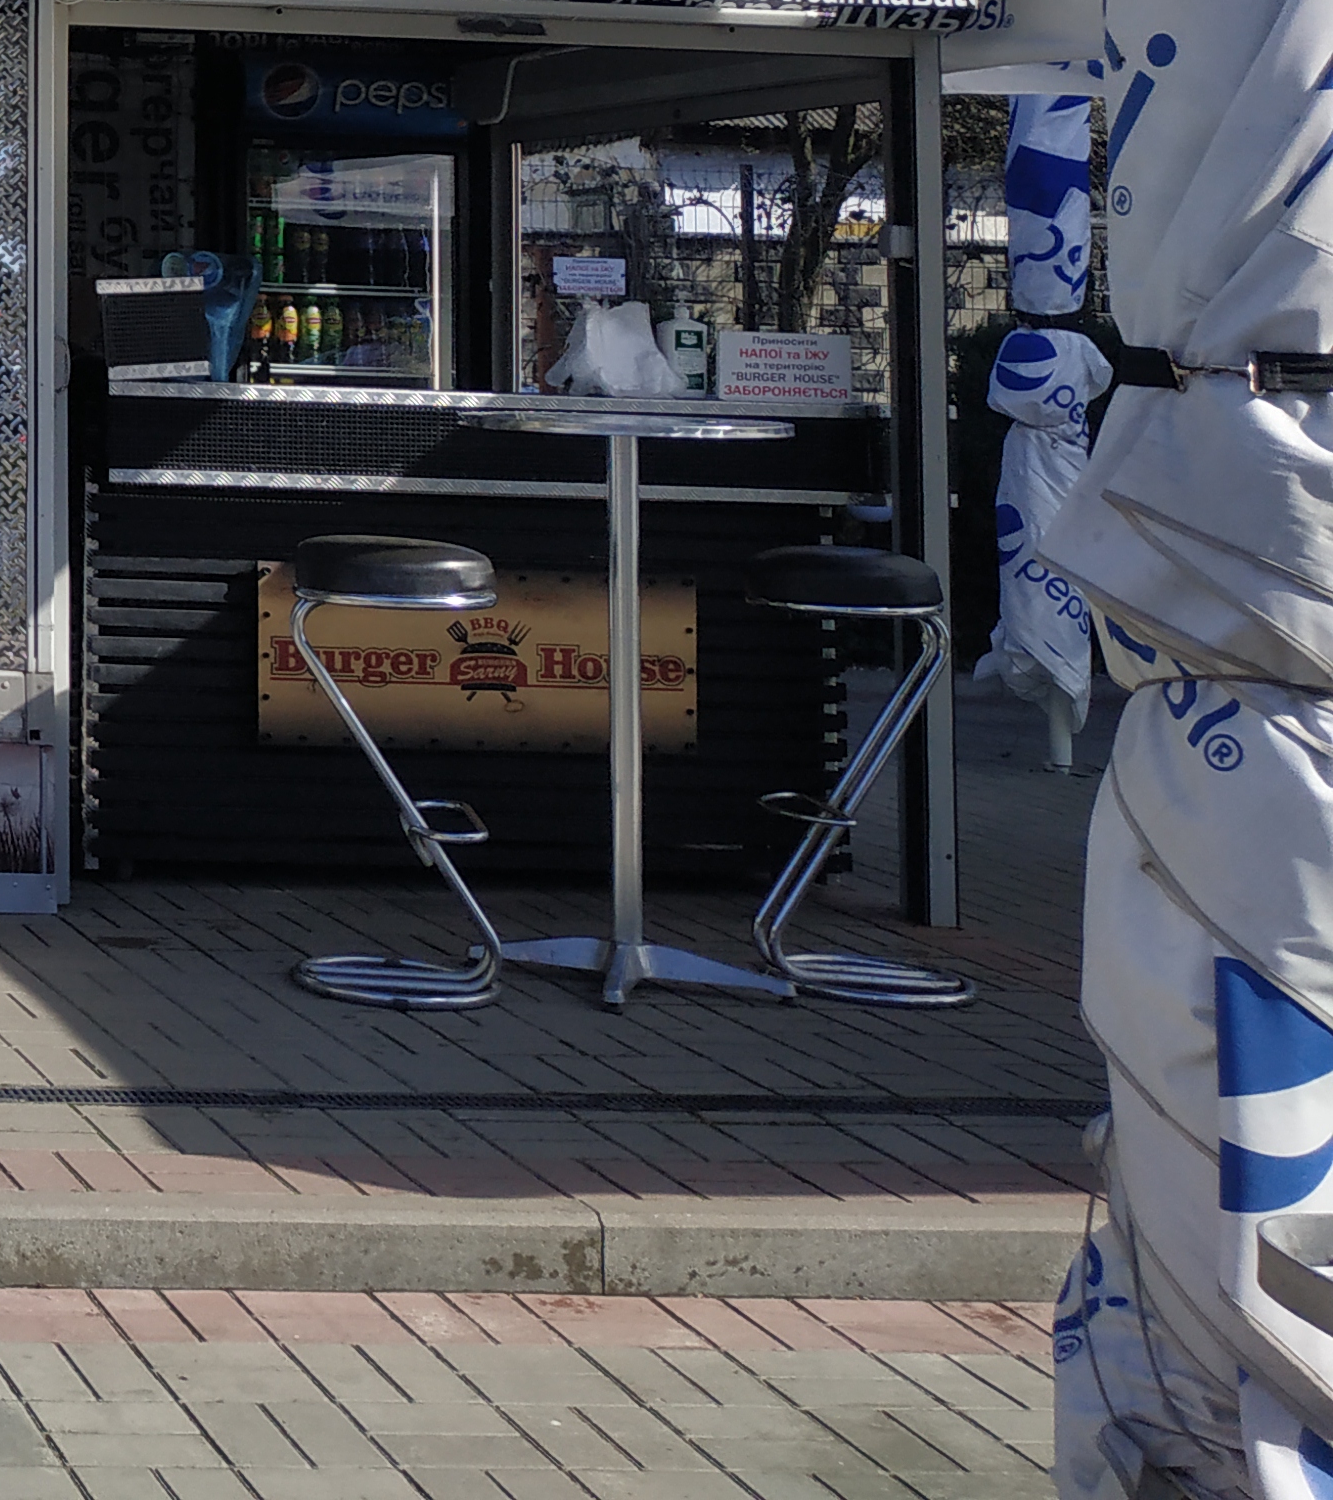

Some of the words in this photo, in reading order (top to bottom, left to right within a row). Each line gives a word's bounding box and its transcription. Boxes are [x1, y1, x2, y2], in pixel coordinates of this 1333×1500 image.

[335, 79, 453, 114] peps
[752, 336, 818, 348] Приносити
[739, 347, 784, 361] НАПОЇ
[787, 350, 801, 361] та
[804, 348, 831, 363] ЇЖУ
[745, 362, 762, 372] на
[764, 362, 825, 374] територію
[724, 385, 848, 400] ЗАБОРОНЯЄТЬСЯ
[469, 617, 510, 634] BBQ
[458, 661, 518, 683] Sarny
[537, 644, 685, 685] Hose
